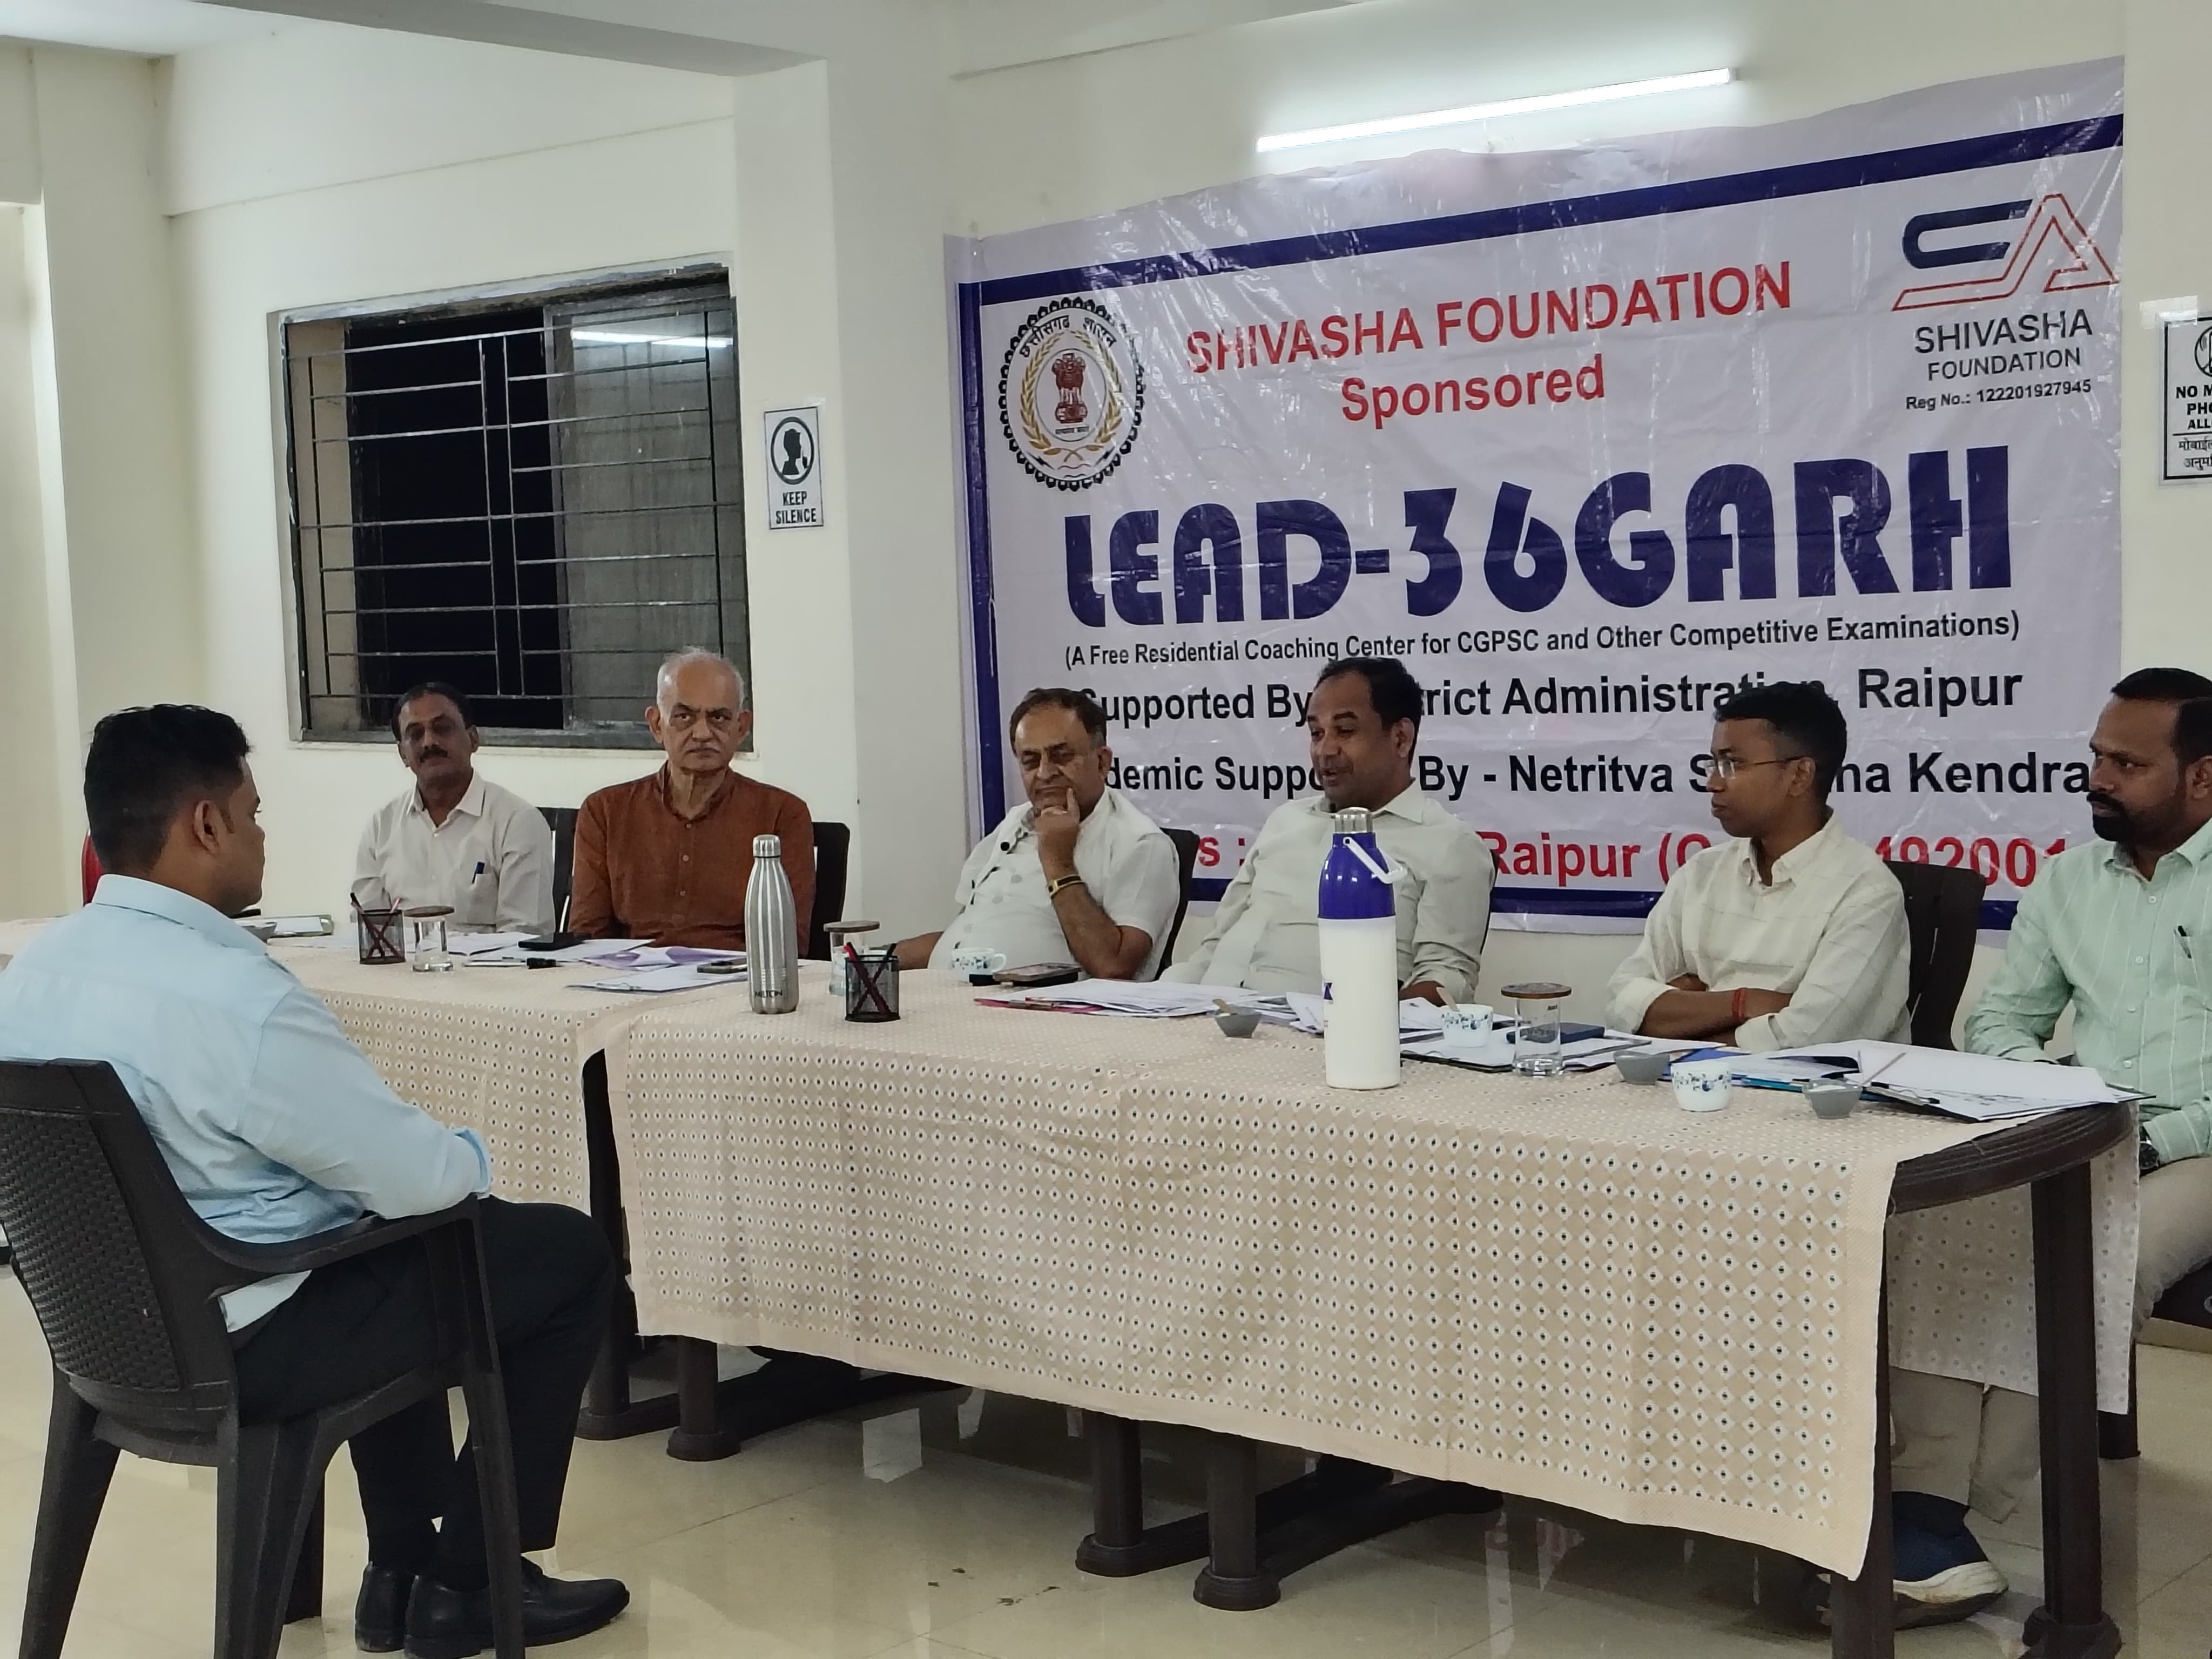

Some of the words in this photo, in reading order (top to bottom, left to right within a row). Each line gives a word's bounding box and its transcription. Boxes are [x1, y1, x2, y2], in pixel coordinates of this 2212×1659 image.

[1188, 306, 1422, 374] SHIVASHA
[1437, 261, 1791, 346] FOUNDATION
[1915, 309, 2092, 354] SHIVASHA
[1928, 347, 2081, 381] FOUNDATION
[1342, 353, 1606, 429] Sponsored
[1906, 396, 1936, 411] Reg
[1941, 393, 1971, 407] No.:
[1977, 379, 2092, 402] 122201927945
[2176, 385, 2198, 399] NO
[775, 508, 817, 524] SILENCE
[783, 490, 807, 506] KEEP
[1064, 446, 2012, 627] LEAD-36GARH
[1065, 646, 1085, 671] (A
[1090, 645, 1129, 665] Free
[1135, 639, 1239, 663] Residential
[1245, 636, 1339, 660] Coaching
[1346, 635, 1415, 656] Center
[1422, 632, 1451, 654] for
[1458, 629, 1539, 653] CGPSC
[1547, 627, 1589, 650] and
[1596, 625, 1662, 648] Other
[1670, 619, 1818, 650] Competitive
[1827, 610, 2020, 641] Examinations)
[1267, 683, 1314, 727] By
[1858, 666, 2024, 718] Raipur
[1419, 756, 1469, 801] By
[1483, 773, 1496, 782] -
[1509, 754, 1673, 793] Netritva
[1908, 751, 2090, 793] Kendra
[1476, 832, 1641, 887] Raipur
